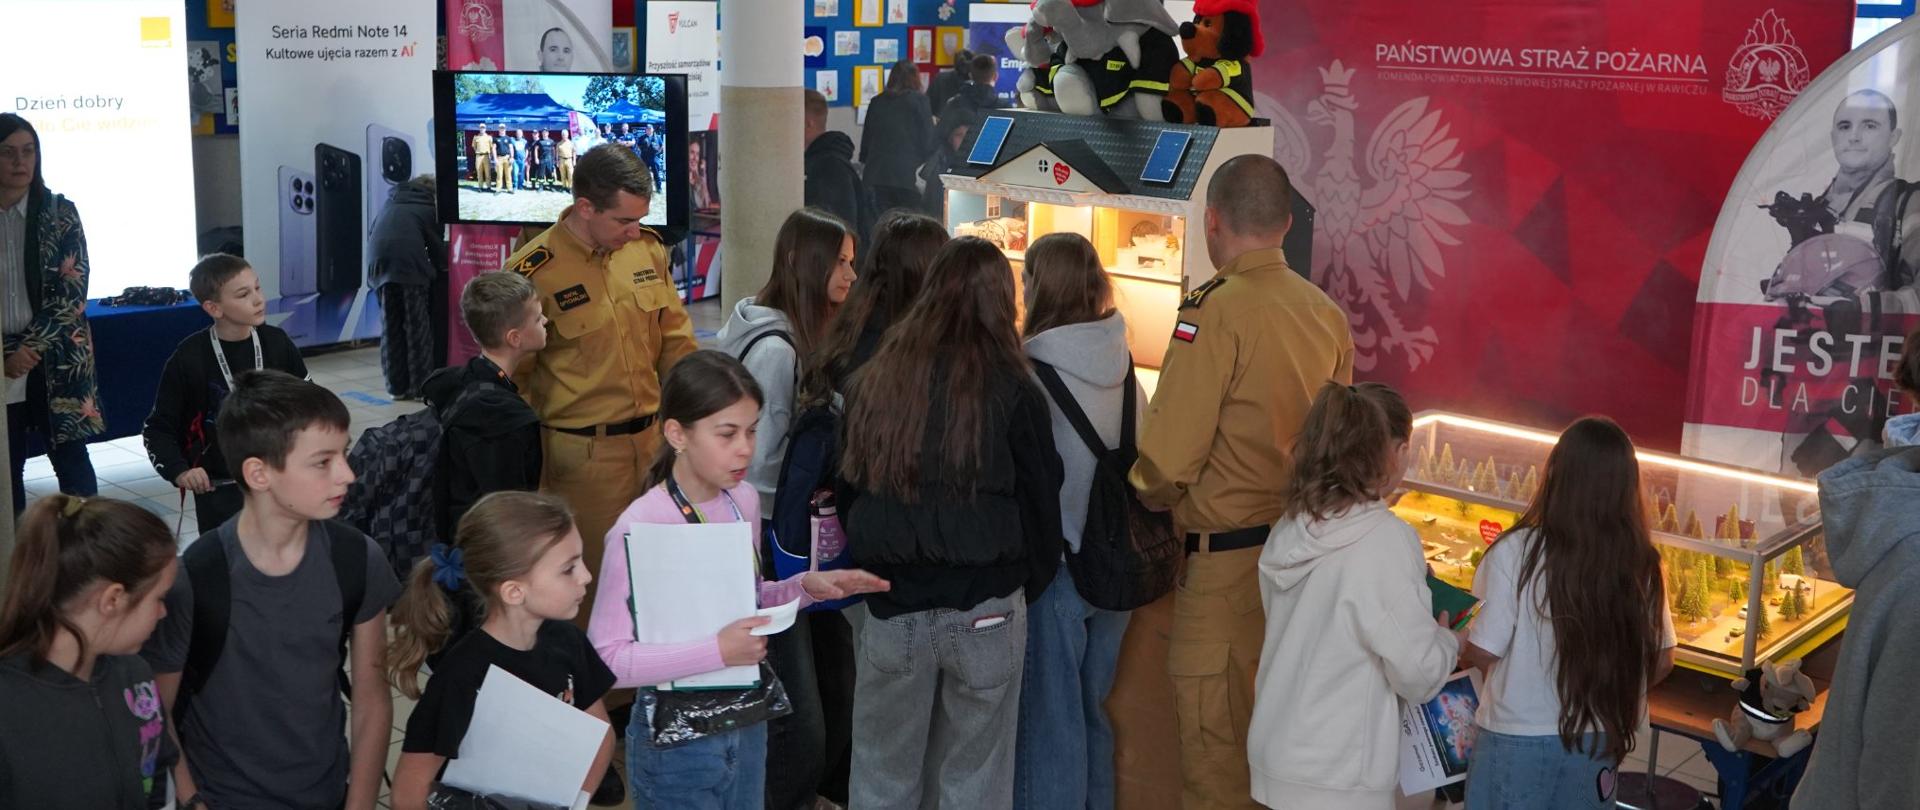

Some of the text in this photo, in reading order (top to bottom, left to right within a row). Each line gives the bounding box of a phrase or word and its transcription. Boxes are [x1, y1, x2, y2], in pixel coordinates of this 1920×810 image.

[271, 24, 408, 39] Seria Redmi Note 14
[266, 47, 314, 60] Kultowe
[317, 46, 351, 61] ujęcia
[355, 47, 389, 58] razem
[392, 48, 397, 58] z
[1375, 39, 1708, 75] PAŃSTWOWA STRAŻ POŻARNA
[1377, 71, 1423, 82] KOMENDA
[1424, 72, 1482, 84] POWIATOWA
[1657, 83, 1708, 96] RAWICZU
[15, 94, 124, 111] Dzień dobry
[1741, 376, 1916, 419] DLA CIE
